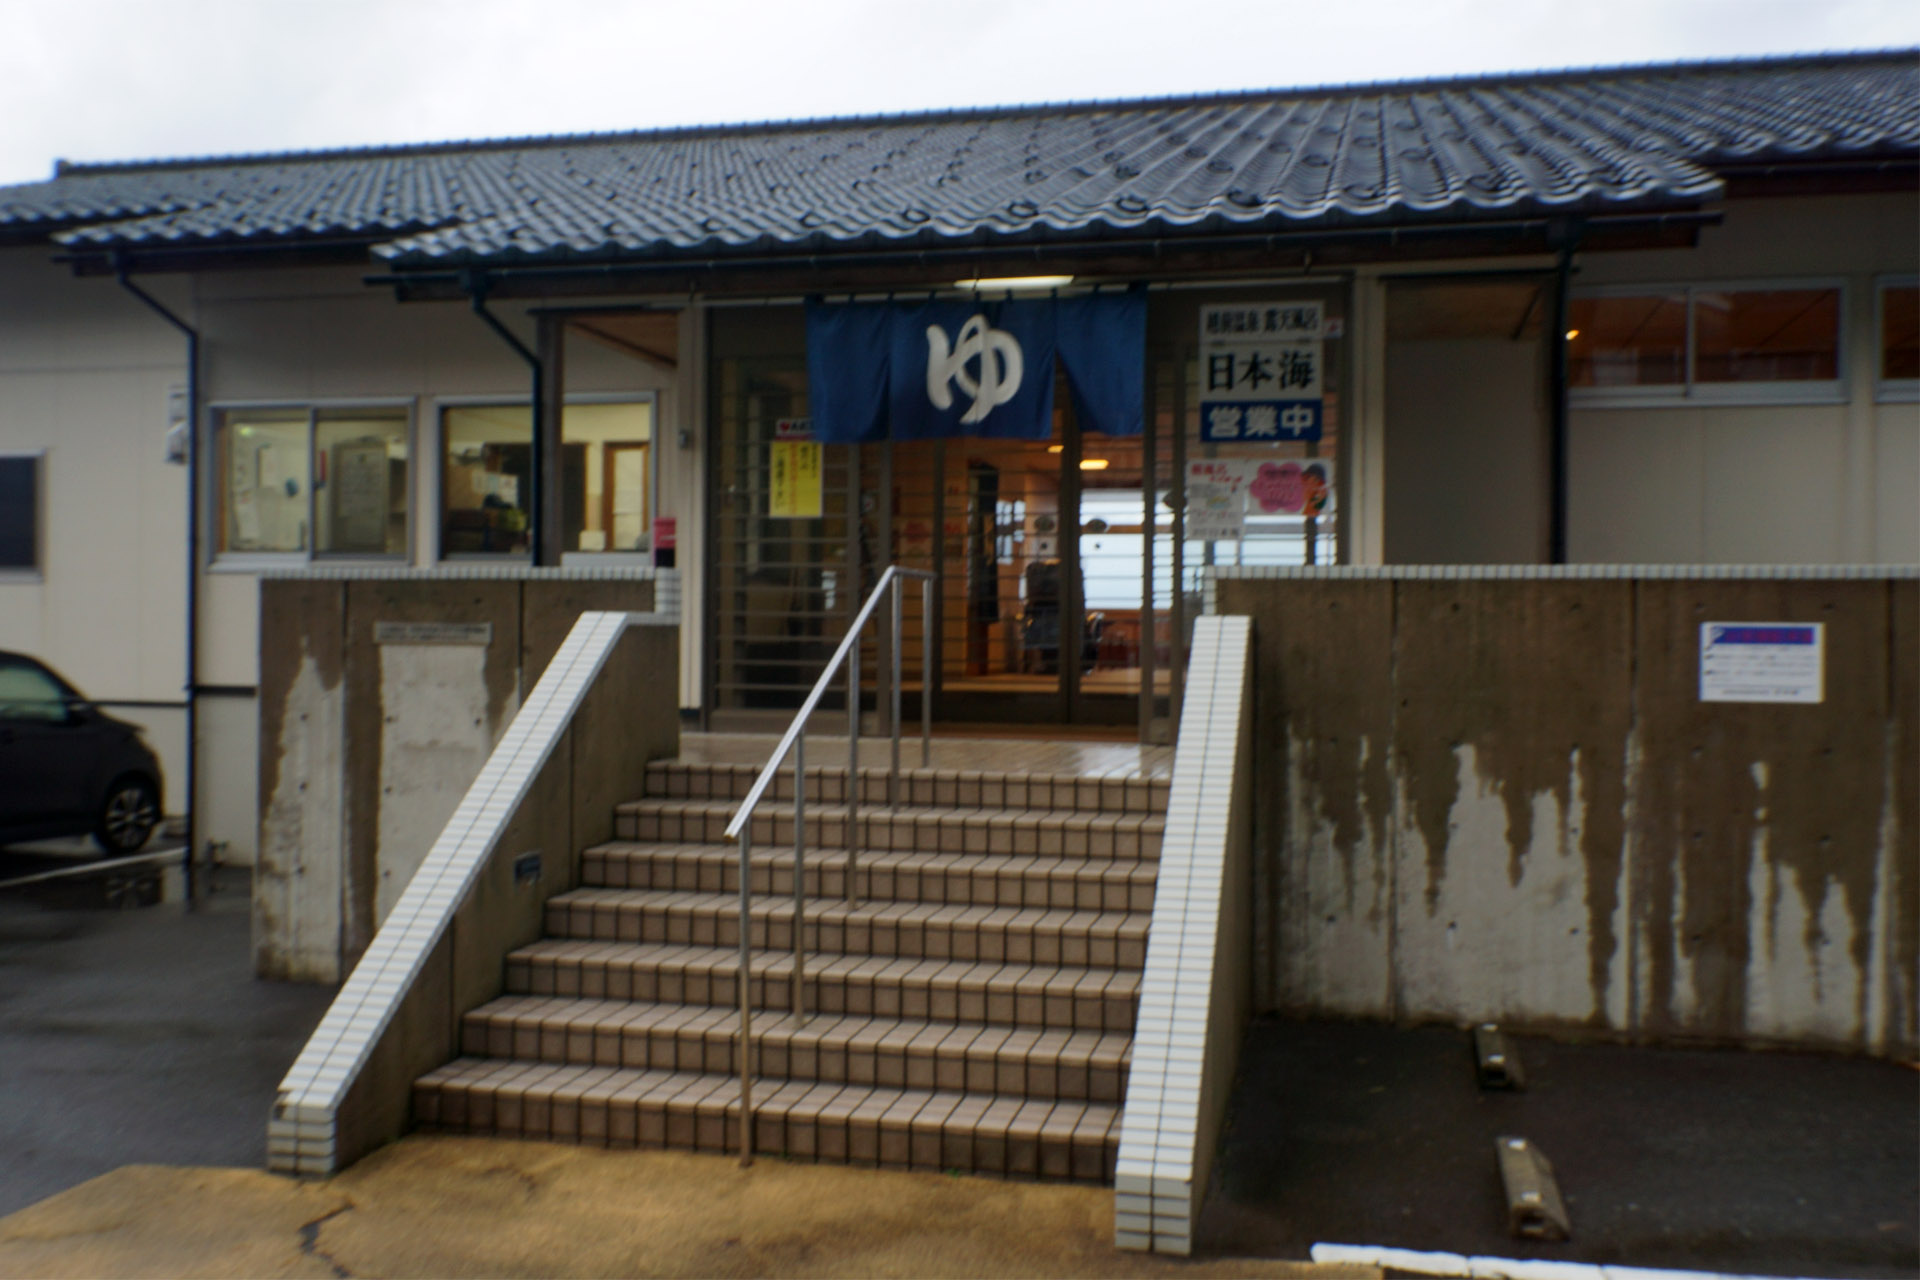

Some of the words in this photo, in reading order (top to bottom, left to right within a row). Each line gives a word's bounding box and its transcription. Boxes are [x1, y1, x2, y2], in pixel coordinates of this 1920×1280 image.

[925, 313, 1024, 425] ゆ
[1208, 349, 1315, 392] 日本海
[1208, 403, 1315, 438] 営業中
